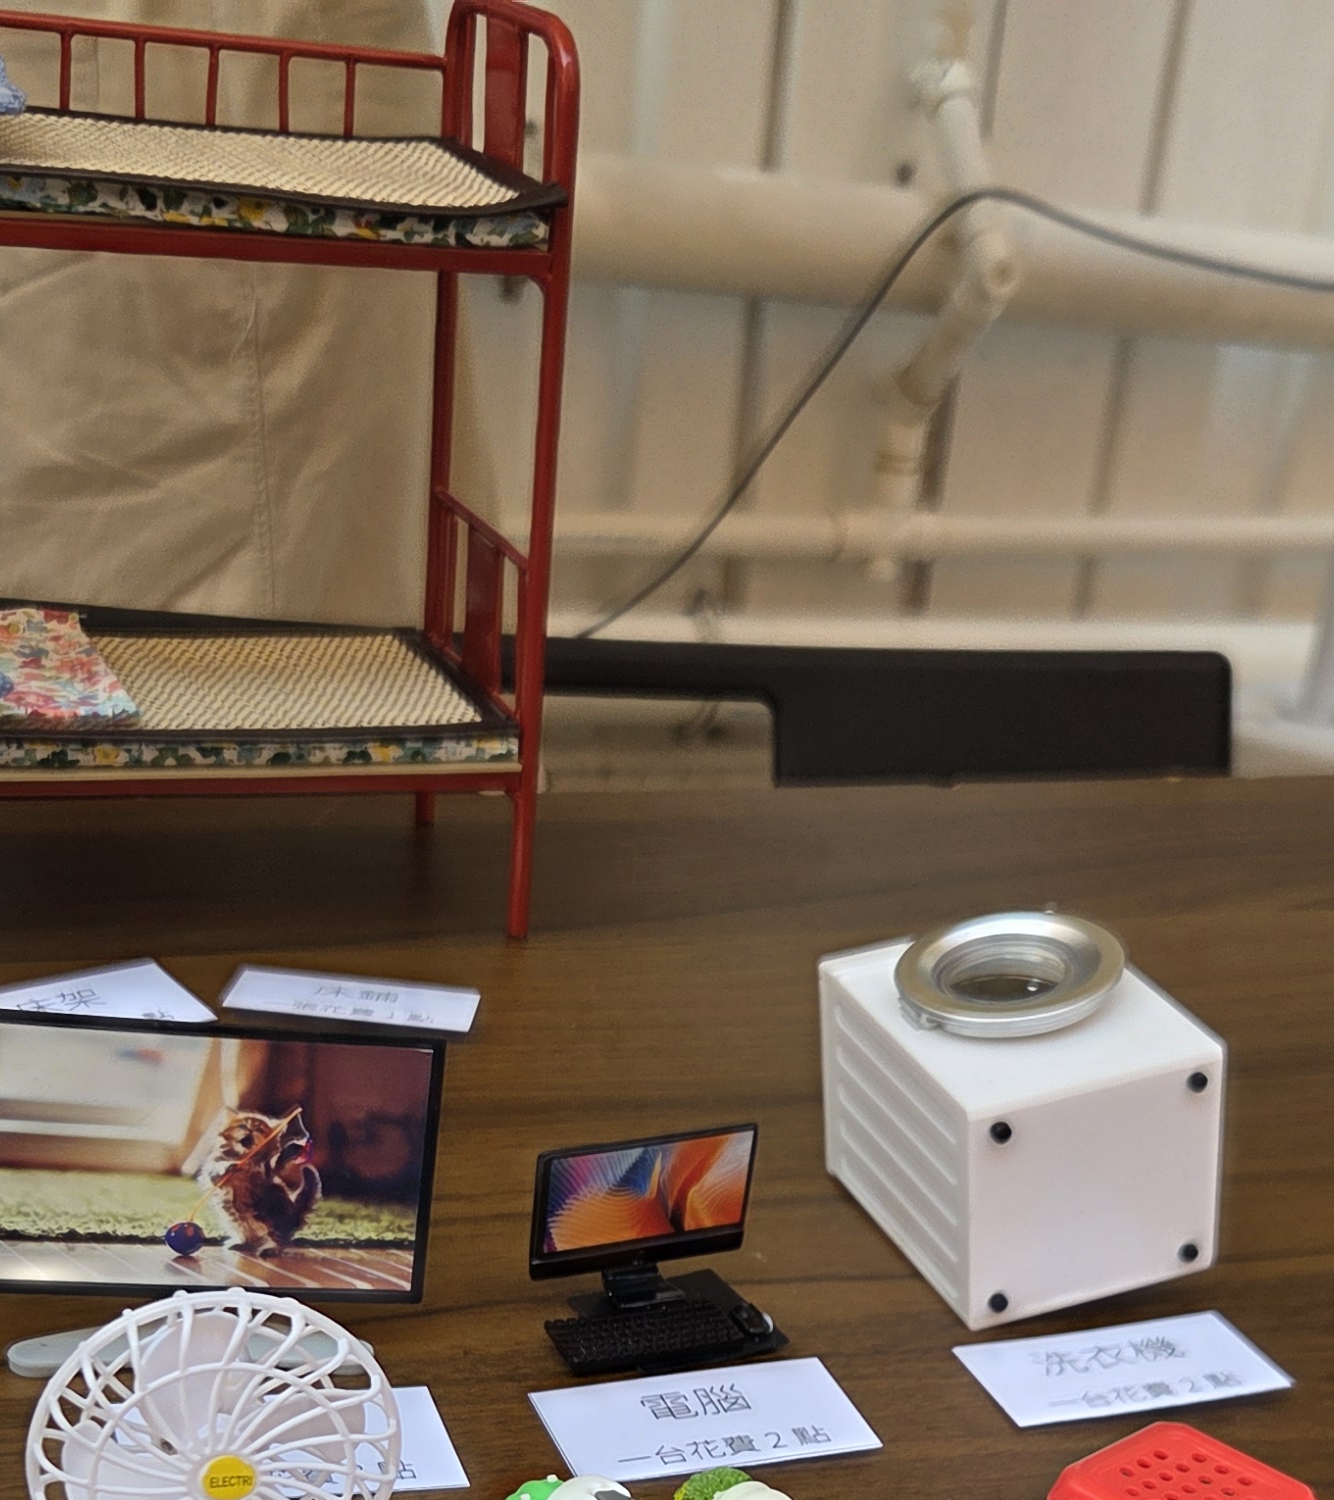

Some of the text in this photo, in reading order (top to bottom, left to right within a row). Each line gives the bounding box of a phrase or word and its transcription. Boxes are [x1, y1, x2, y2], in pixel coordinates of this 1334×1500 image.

[1029, 1337, 1185, 1377] 洗衣機
[641, 1383, 752, 1420] 電腦
[1177, 1376, 1204, 1393] 2
[618, 1424, 832, 1465] 一台花費 2 點
